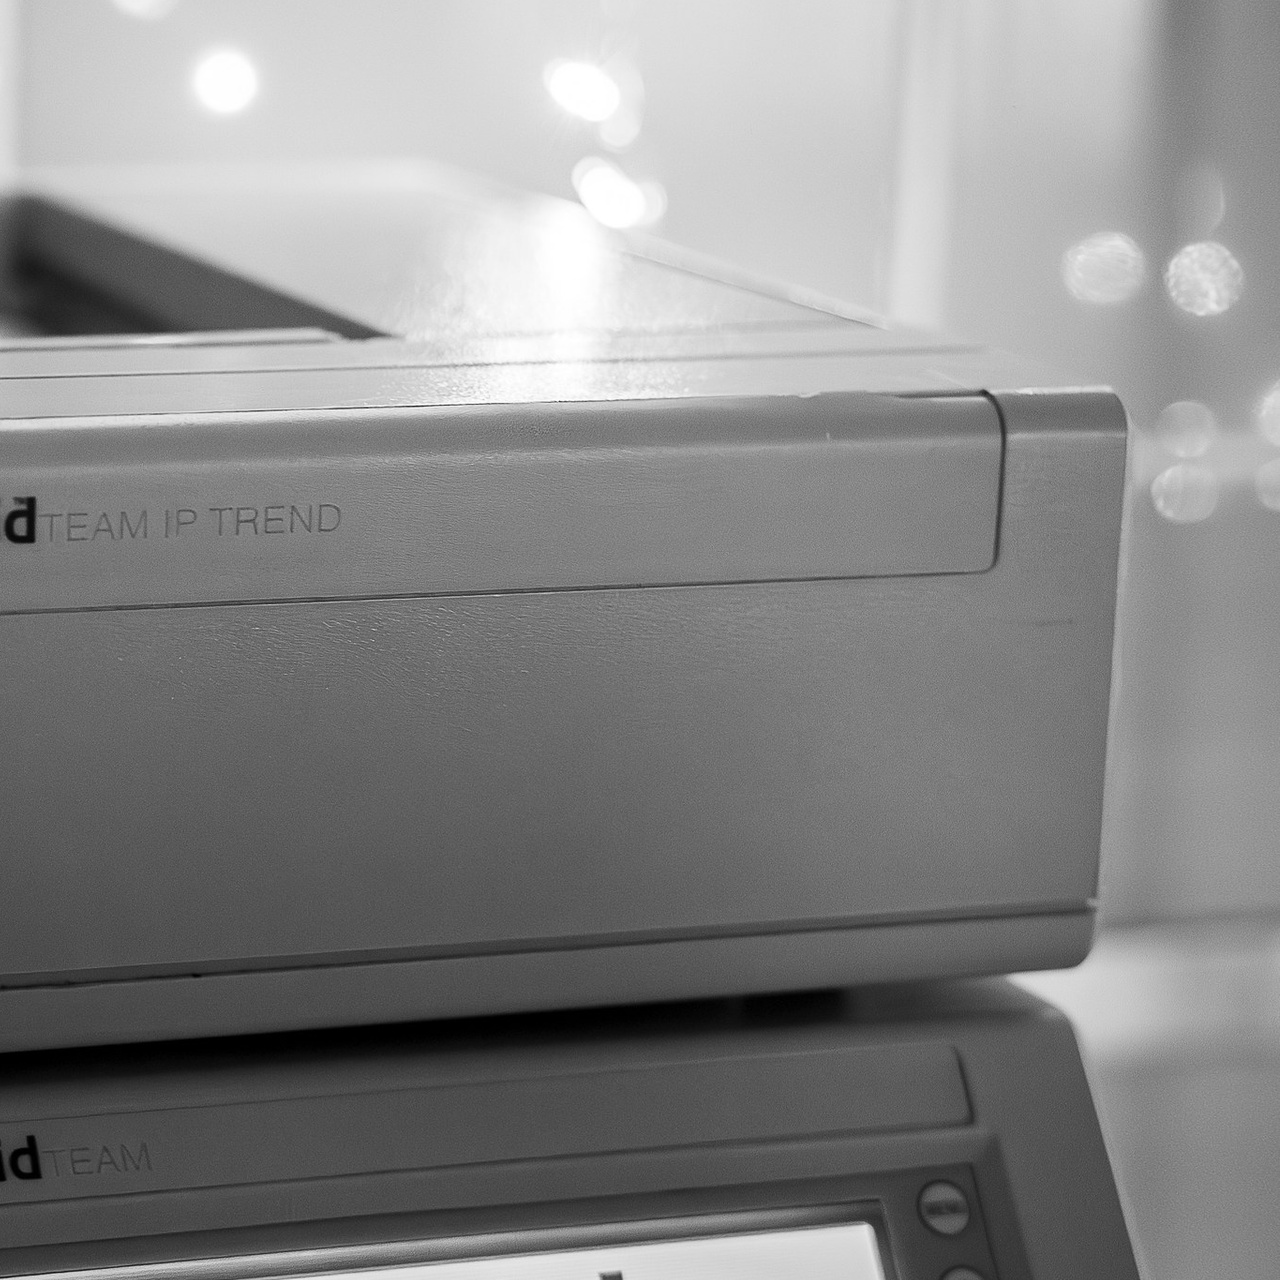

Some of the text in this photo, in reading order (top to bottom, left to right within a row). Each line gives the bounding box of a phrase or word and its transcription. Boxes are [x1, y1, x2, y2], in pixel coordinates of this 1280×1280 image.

[40, 510, 148, 542] TEAM
[164, 508, 199, 539] IP
[209, 503, 343, 537] TREND
[43, 1141, 153, 1177] TEAM
